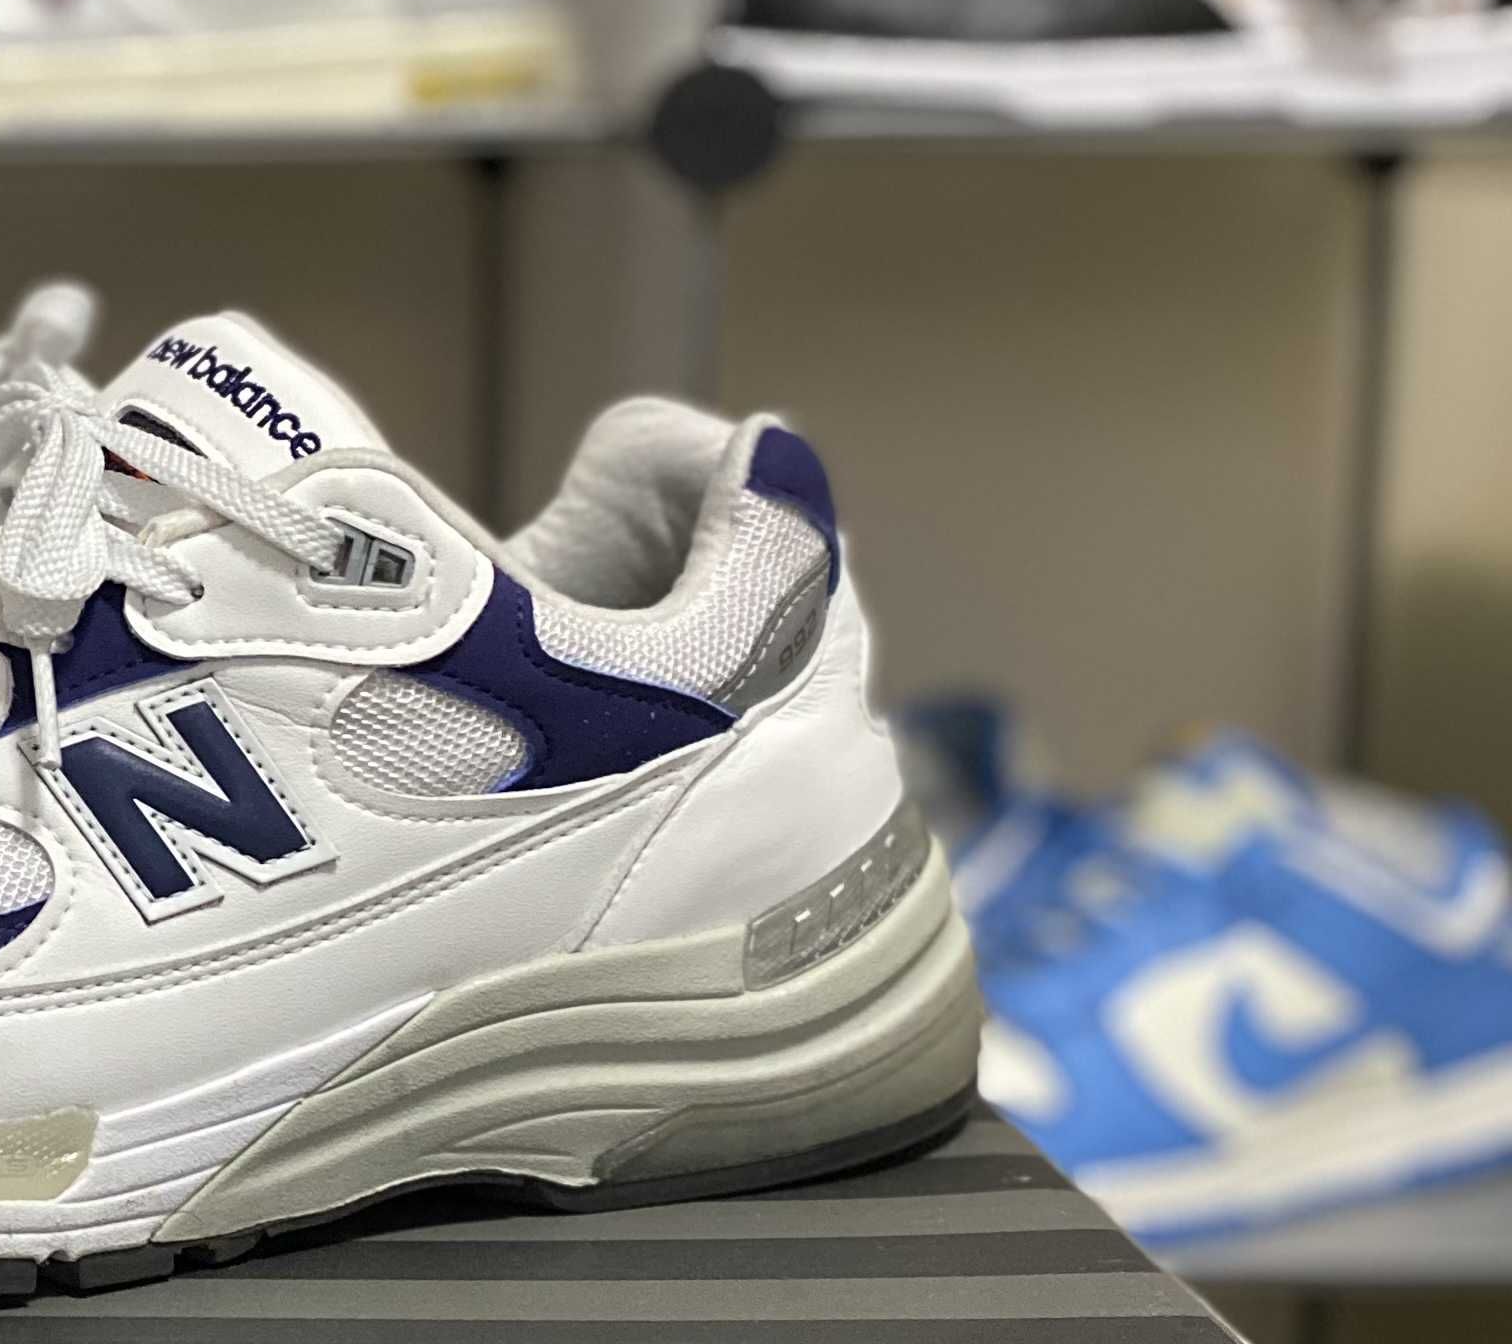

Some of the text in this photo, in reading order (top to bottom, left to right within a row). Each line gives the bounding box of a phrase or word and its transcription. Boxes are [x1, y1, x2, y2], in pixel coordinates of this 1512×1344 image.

[147, 336, 322, 460] new balance
[41, 690, 324, 911] N
